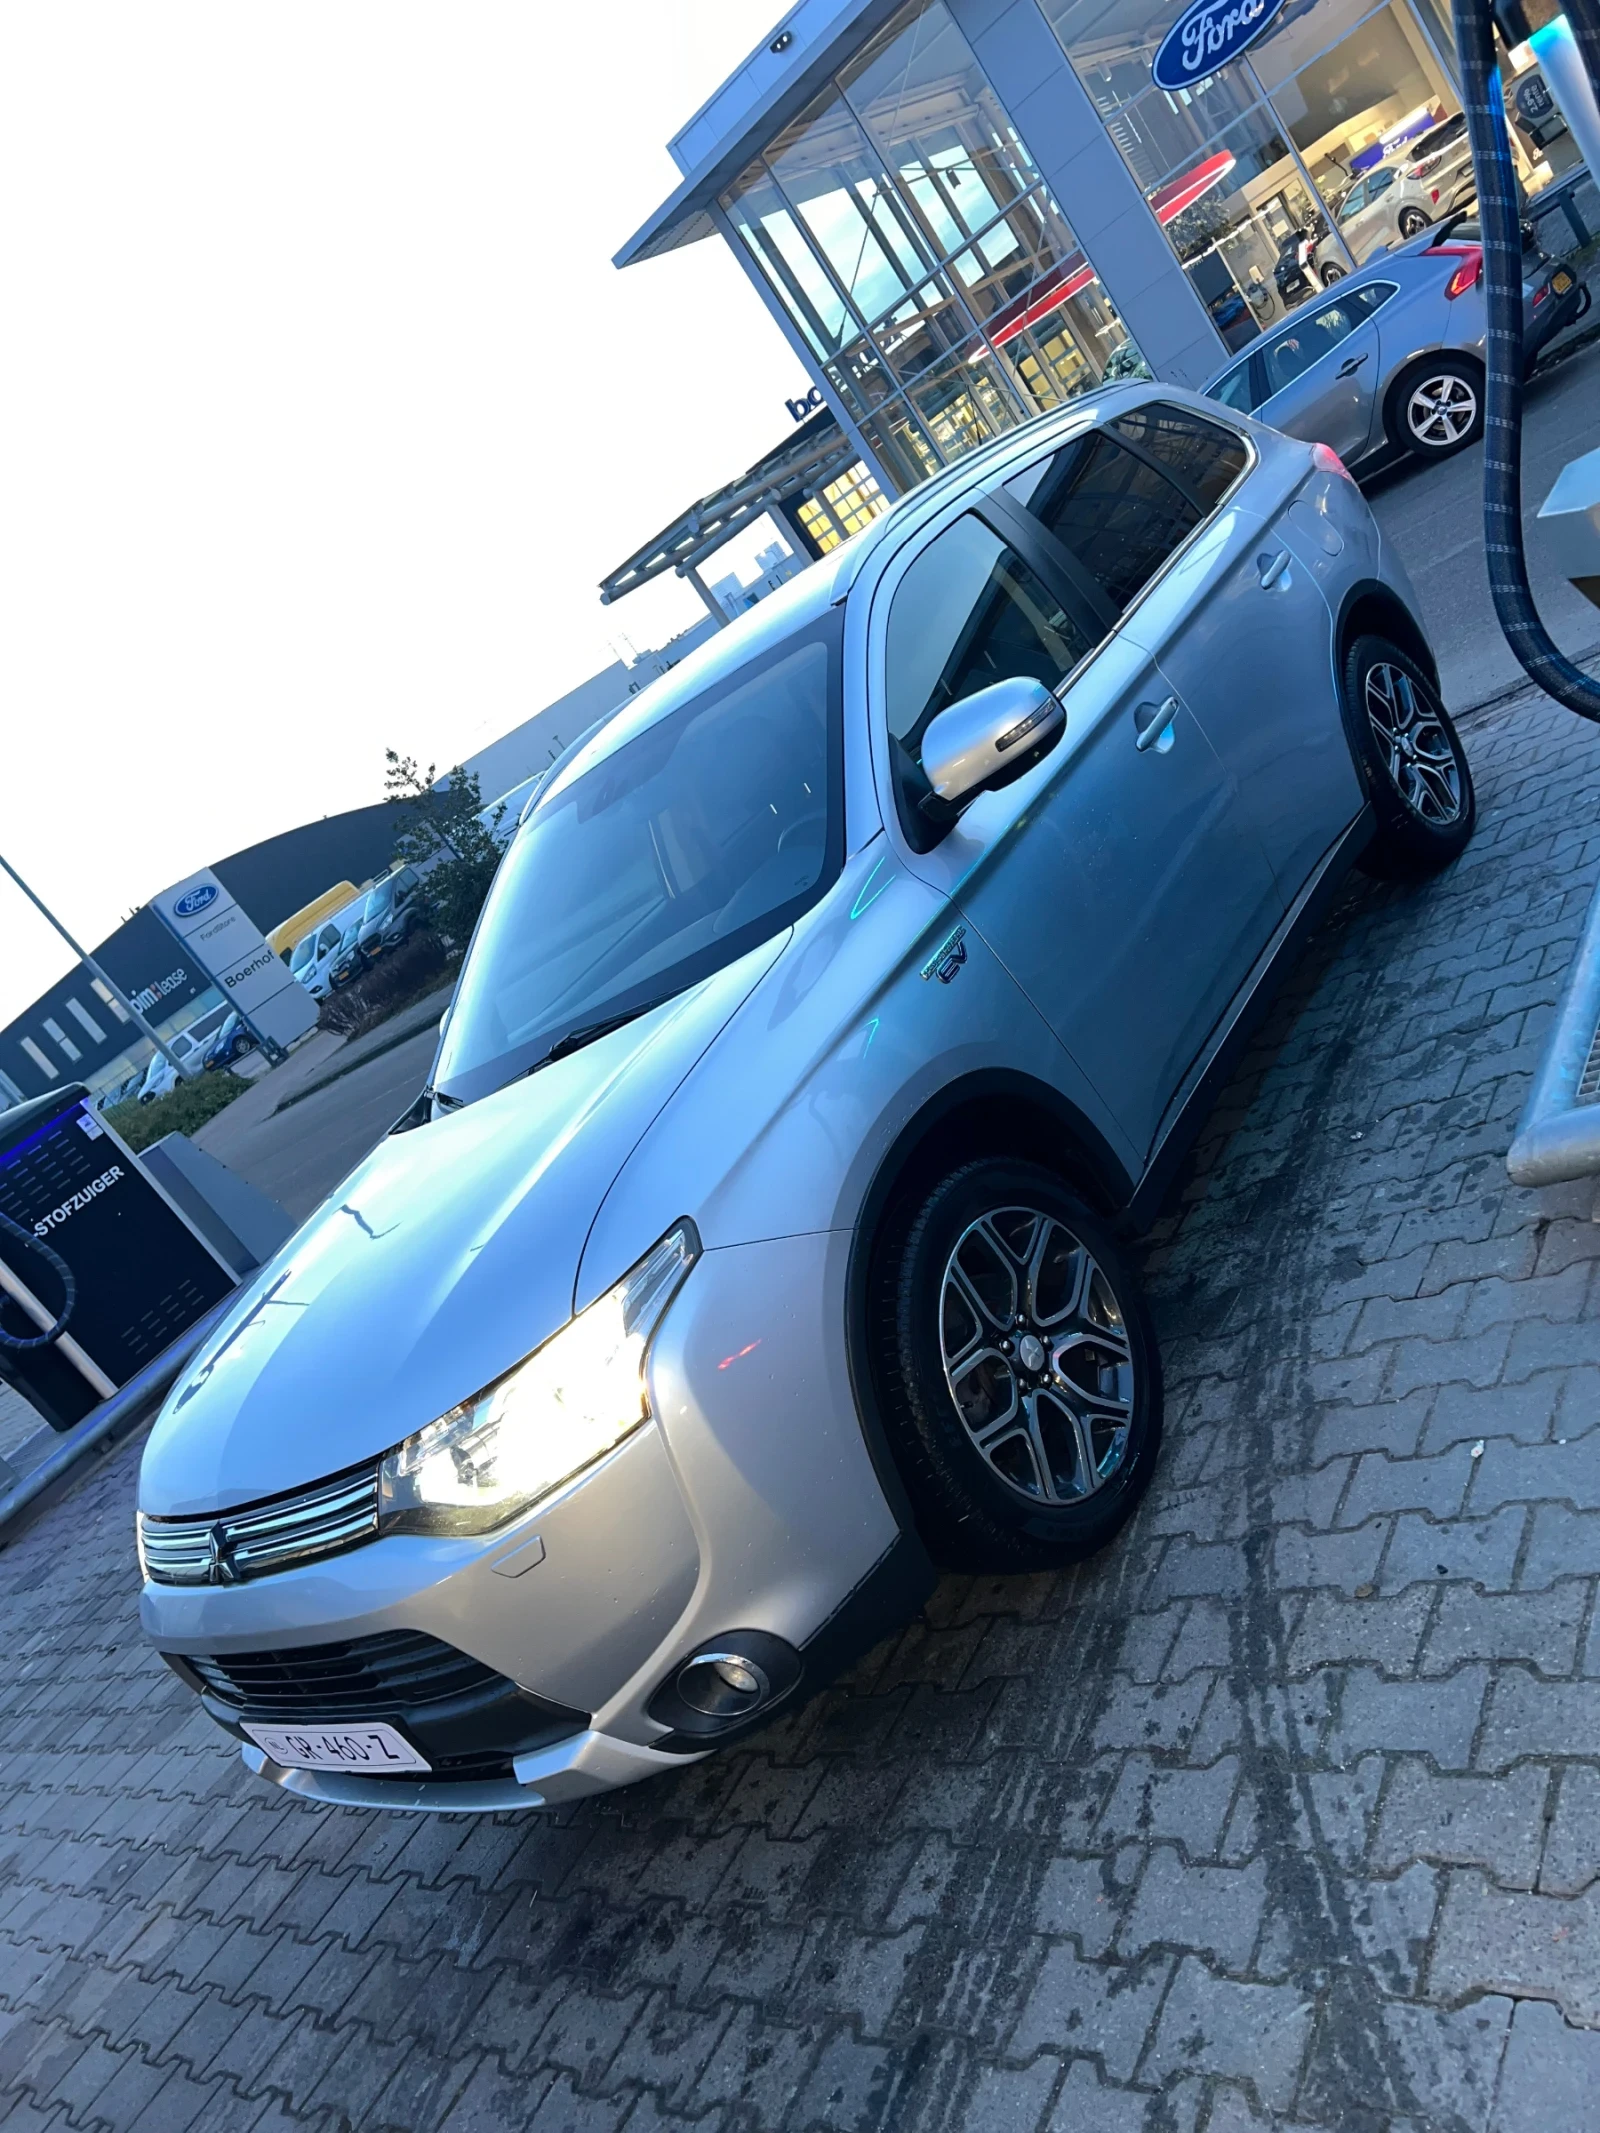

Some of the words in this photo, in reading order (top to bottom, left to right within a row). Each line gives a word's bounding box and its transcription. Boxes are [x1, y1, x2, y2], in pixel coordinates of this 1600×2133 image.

[1181, 0, 1264, 71] Ford
[184, 888, 212, 911] Ford
[200, 916, 236, 941] FordStore
[224, 949, 275, 988] Boerhof
[935, 941, 968, 984] EV
[285, 1734, 401, 1761] GR-460-Z
